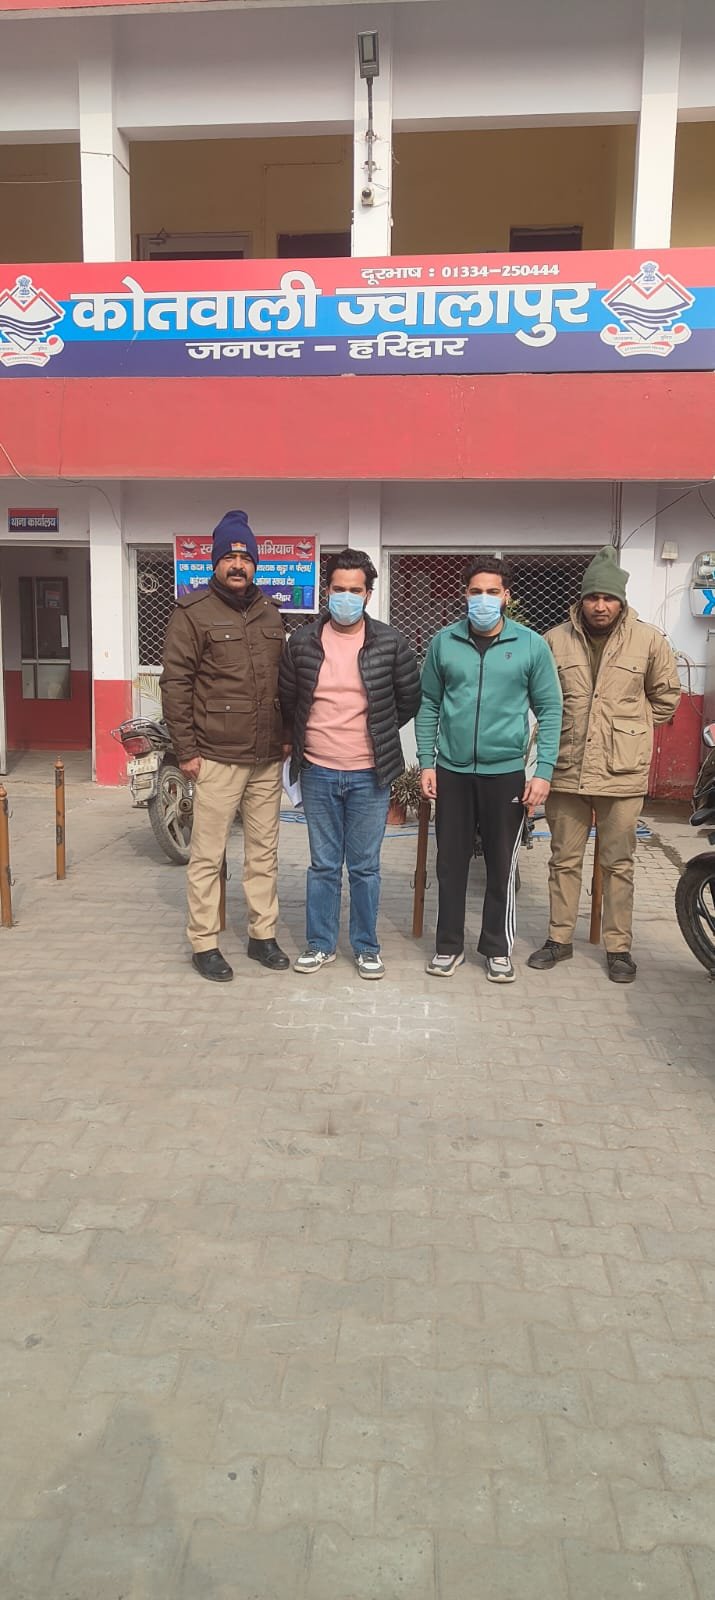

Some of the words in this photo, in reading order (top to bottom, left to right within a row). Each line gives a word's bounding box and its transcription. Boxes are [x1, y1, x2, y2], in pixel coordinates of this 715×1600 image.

[361, 266, 422, 285] दूरभाष
[441, 263, 560, 279] 01334-250444
[70, 270, 322, 332] कोतवाली
[336, 282, 597, 347] ज्वालापुर
[185, 341, 304, 360] जनपद
[347, 331, 469, 360] हरिद्वार
[11, 517, 26, 527] थाना
[27, 514, 56, 527] कार्यालय
